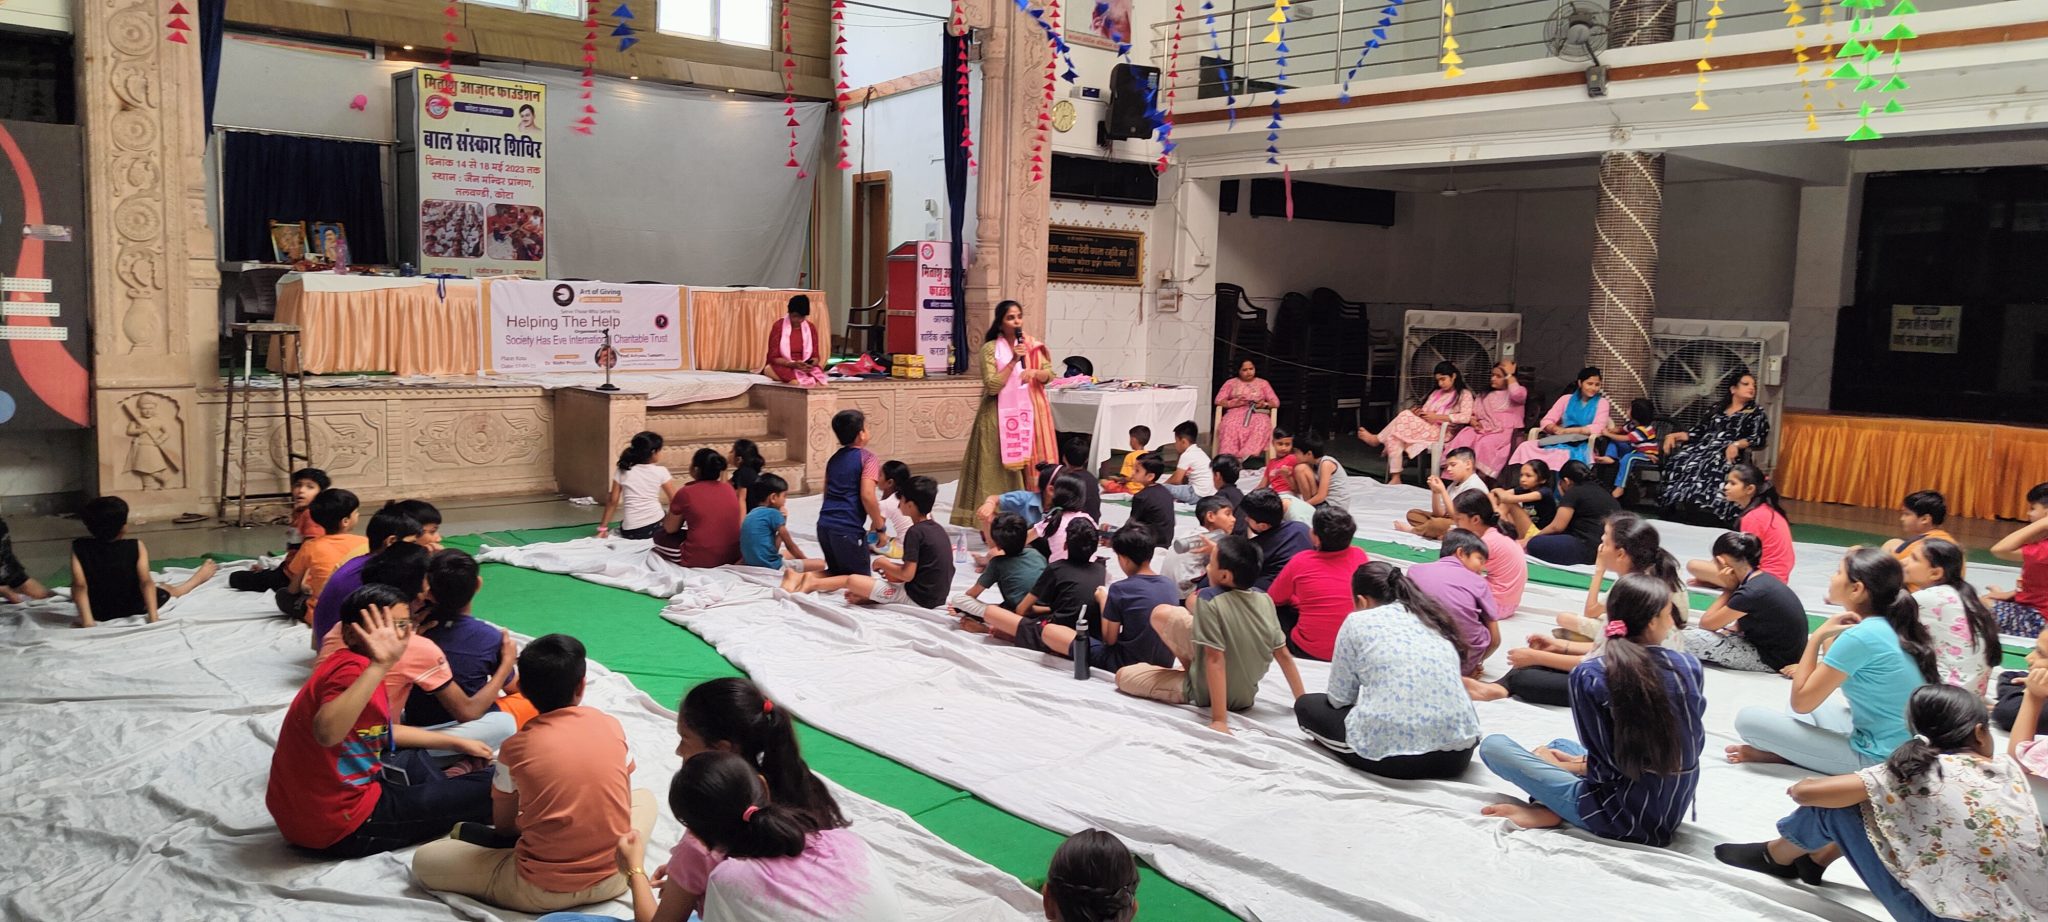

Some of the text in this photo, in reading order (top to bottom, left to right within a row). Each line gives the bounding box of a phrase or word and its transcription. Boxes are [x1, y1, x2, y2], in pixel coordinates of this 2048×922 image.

[497, 84, 541, 102] फाउंडेशन
[423, 128, 542, 158] बाल संस्कार शिविर
[425, 154, 541, 174] दिनांक 14 से 18 मई 2023 तक
[432, 172, 456, 182] स्थान
[464, 172, 480, 183] जैन
[494, 188, 514, 200] कोटा
[922, 264, 942, 282] मितांशु
[600, 288, 622, 296] Giving
[506, 315, 620, 330] Helping The Help
[506, 334, 668, 348] Society Has Eve Internationl Charitable Trust
